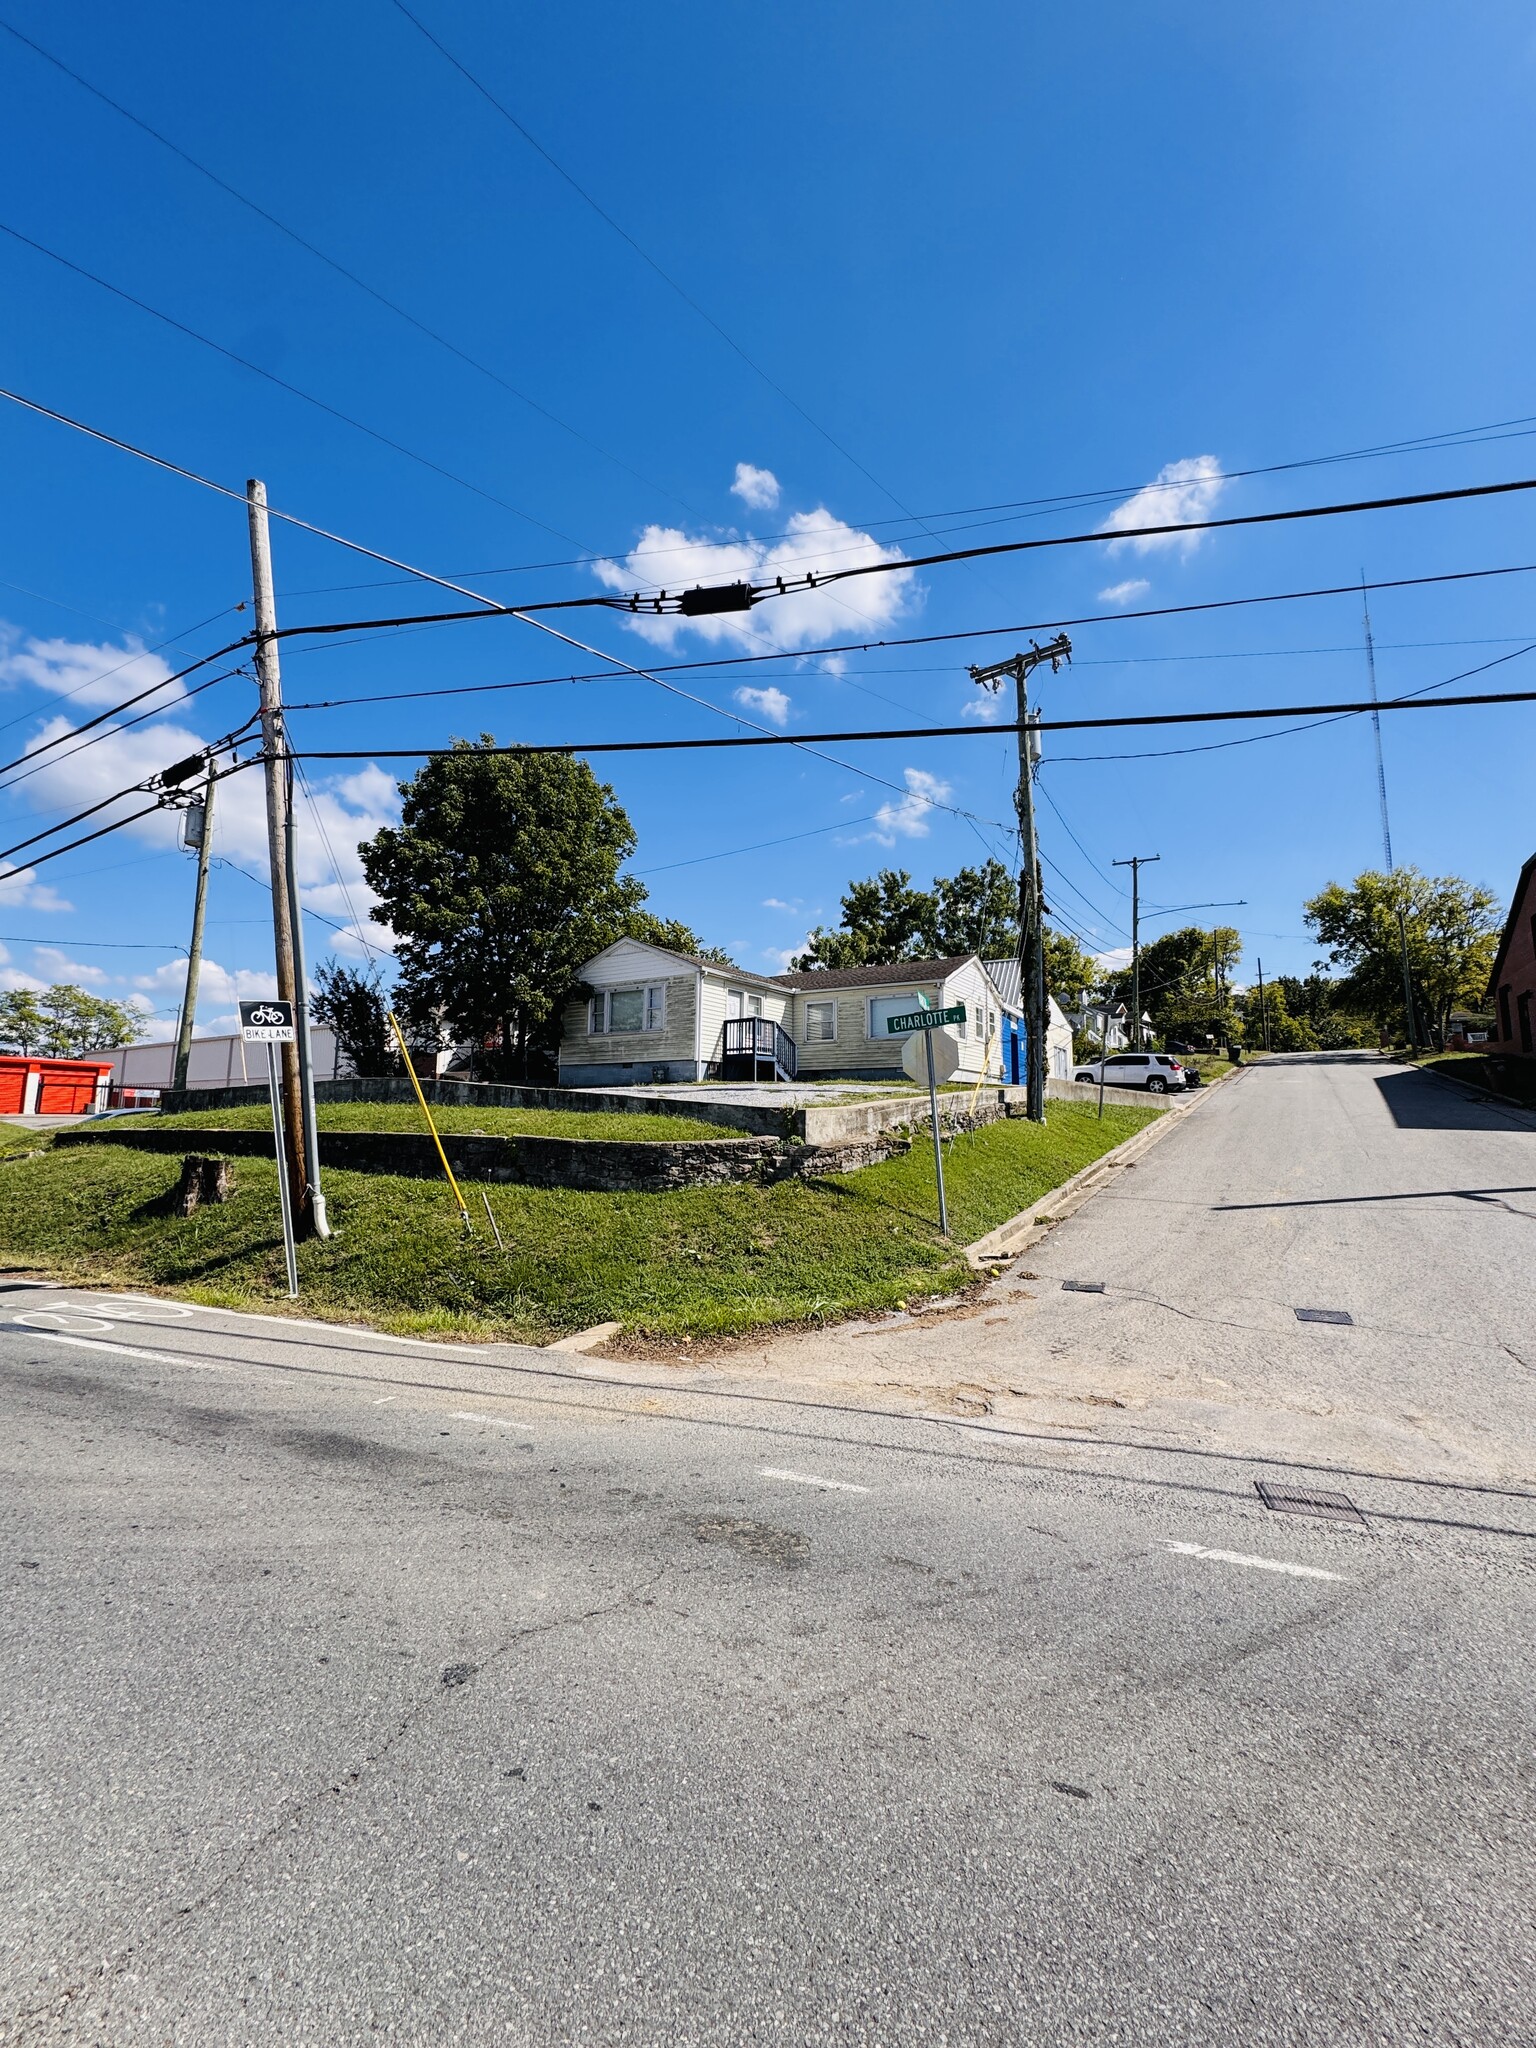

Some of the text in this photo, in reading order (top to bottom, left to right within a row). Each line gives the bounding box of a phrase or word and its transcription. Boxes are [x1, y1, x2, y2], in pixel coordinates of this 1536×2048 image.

[893, 1010, 961, 1031] CHARLOTTE PK
[245, 1029, 293, 1039] BIKE LANE
